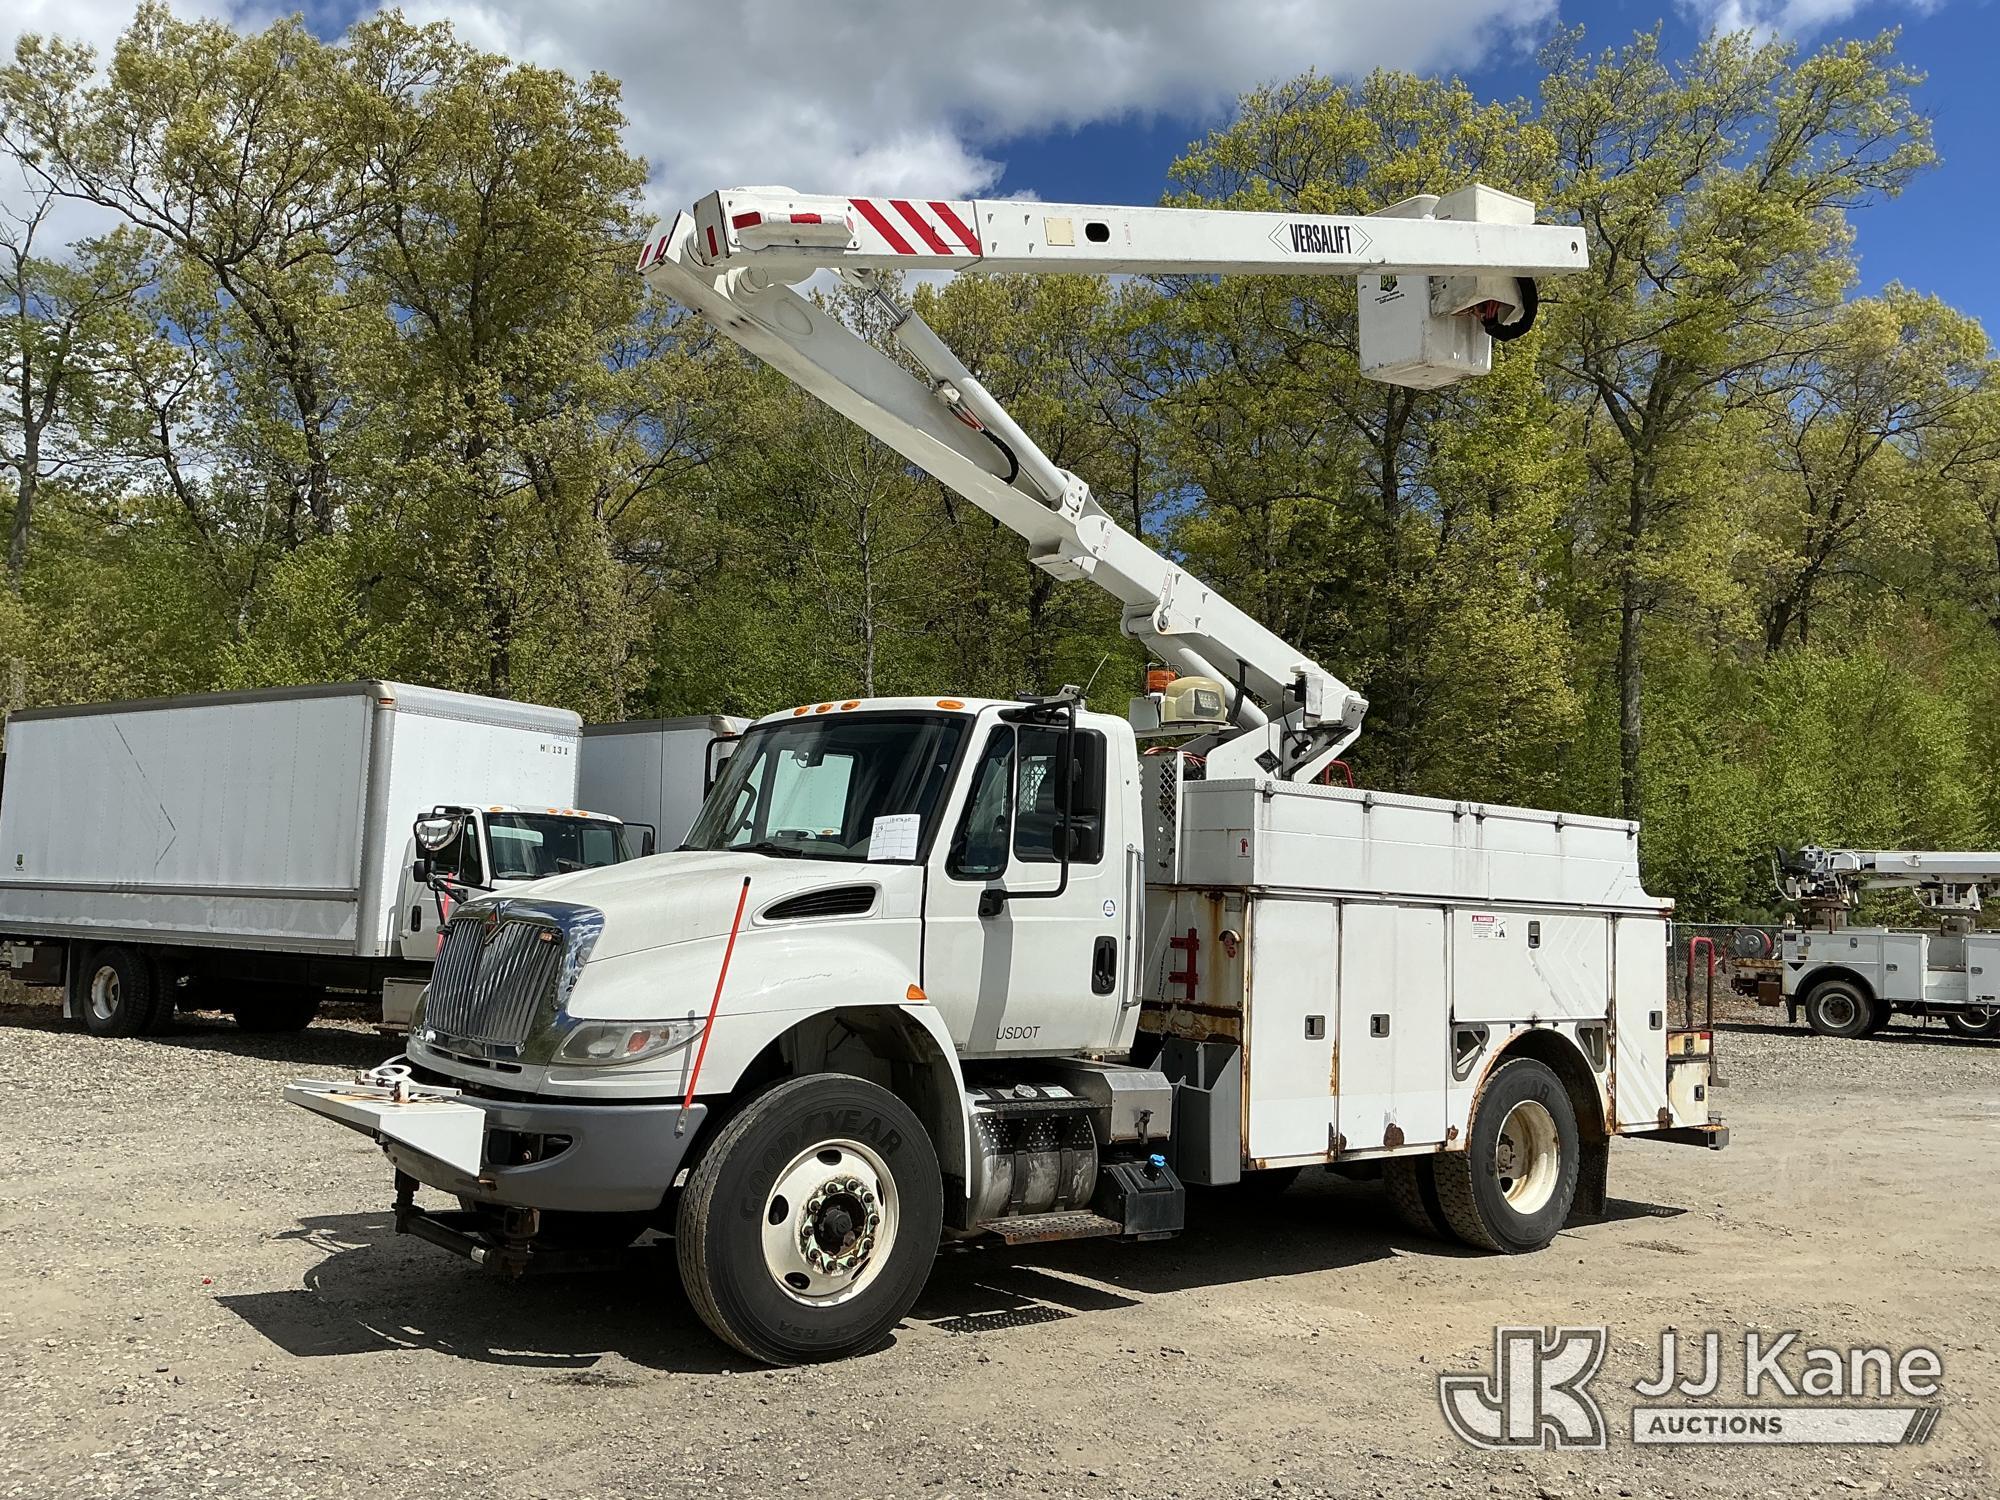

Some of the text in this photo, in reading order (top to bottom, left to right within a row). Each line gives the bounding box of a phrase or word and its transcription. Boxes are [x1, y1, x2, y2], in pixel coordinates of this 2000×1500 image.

[1289, 223, 1351, 254] VERSALIFT
[996, 1026, 1040, 1040] USDOT
[740, 1109, 902, 1221] GOODYEAR
